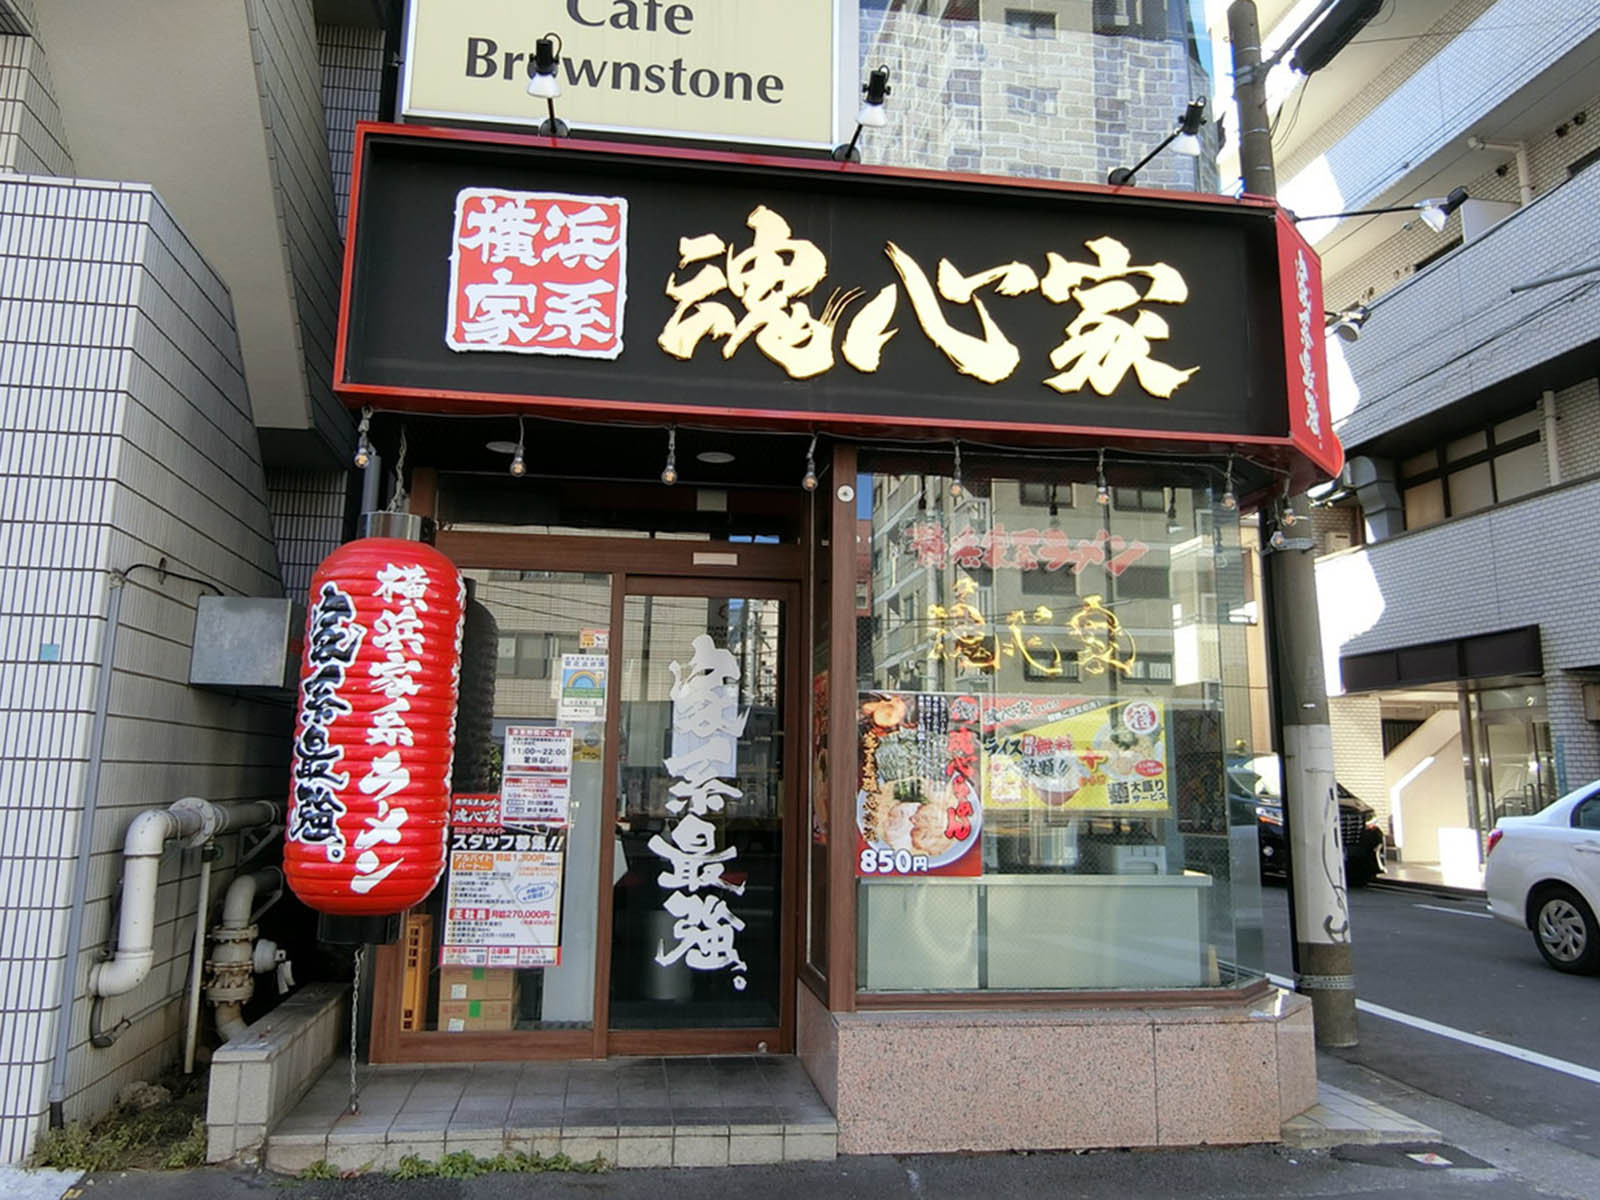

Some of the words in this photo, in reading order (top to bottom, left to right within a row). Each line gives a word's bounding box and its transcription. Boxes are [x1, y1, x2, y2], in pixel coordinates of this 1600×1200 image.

[465, 36, 785, 104] Brwnstone
[657, 204, 1201, 400] 魂心家
[350, 563, 429, 893] 横浜家系ラーメン
[859, 848, 929, 874] 850円
